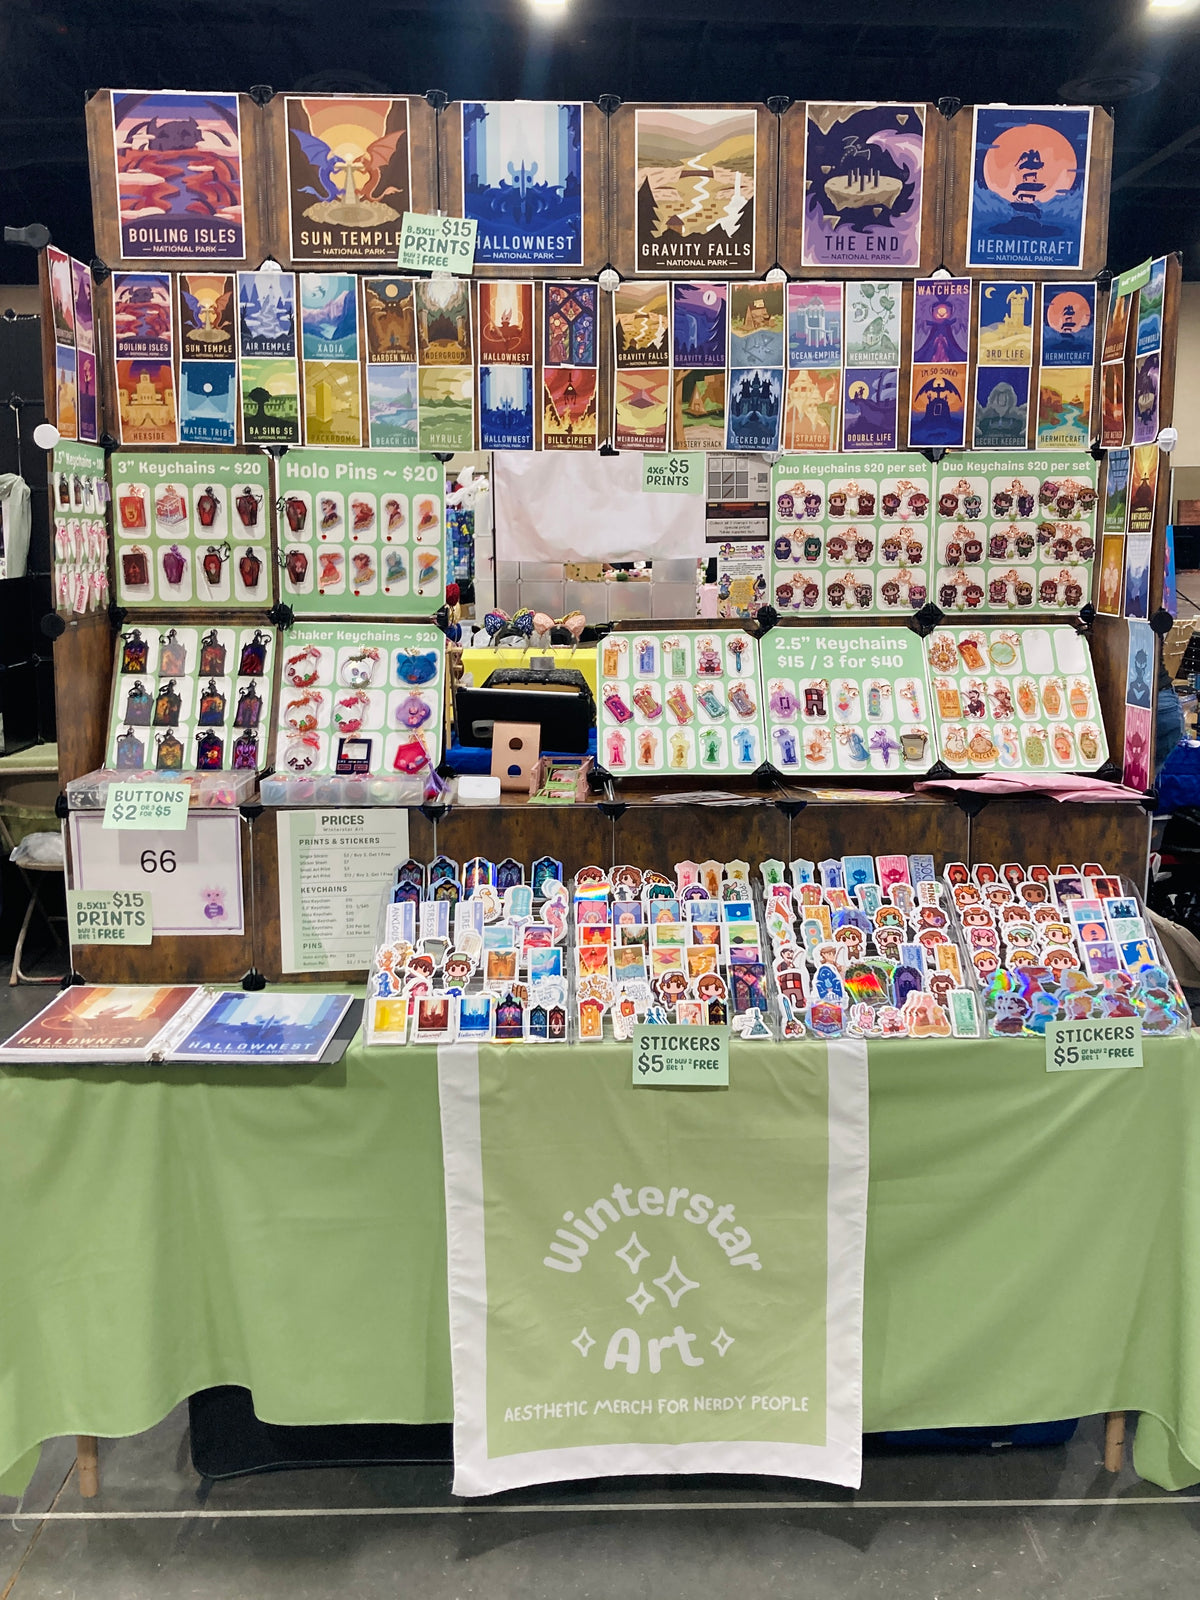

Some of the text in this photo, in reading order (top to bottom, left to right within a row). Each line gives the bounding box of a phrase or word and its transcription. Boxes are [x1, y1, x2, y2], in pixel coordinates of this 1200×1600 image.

[442, 220, 472, 237] $15
[129, 228, 236, 244] BOILING ISLES
[301, 231, 401, 246] SUN TEMPLE
[404, 235, 470, 257] PRINTS
[474, 235, 574, 250] HALLOWNEST
[825, 235, 898, 250] THE END
[977, 239, 1073, 255] HERMITCRAFT
[642, 243, 751, 257] GRAVITY FALLS
[422, 255, 448, 266] FREE
[492, 252, 554, 261] NATIONAL PARK
[831, 253, 869, 261] NATIONAL
[996, 254, 1037, 262] NATIONAL
[918, 285, 969, 295] WATCHERS
[120, 343, 146, 351] BOILING
[204, 345, 232, 353] TEMPLE
[262, 343, 290, 351] TEMPLE
[318, 344, 343, 352] XADIA
[483, 352, 529, 362] HALLOWNEST
[791, 351, 839, 359] OCEAN EMPIRE
[850, 352, 895, 361] HERMITCRAFT
[986, 350, 1024, 358] 3RD LIFE
[1045, 352, 1090, 360] HERMITCRAFT
[183, 427, 207, 435] WATER
[284, 427, 293, 435] SE
[430, 434, 463, 443] HYRULE
[484, 435, 529, 443] HALLOWNEST
[567, 436, 592, 444] CIPHER
[731, 436, 758, 444] DECKED
[139, 461, 215, 477] Keychains
[234, 462, 261, 475] $20
[286, 462, 438, 483] Holo Pins $20
[669, 458, 689, 475] $5
[778, 463, 927, 477] Duo Keychains $20 per set
[942, 461, 1090, 475] Duo Keychains $20 per set
[647, 476, 689, 486] PRINTS
[290, 630, 437, 644] Shaker Keychains $20
[775, 636, 907, 653] 2.5" Keychains
[778, 655, 903, 669] $15 3 for $40
[115, 791, 184, 803] BUTTONS
[112, 803, 137, 822] $2
[155, 805, 171, 817] $5
[322, 816, 364, 825] PRICES
[141, 850, 176, 873] 66
[112, 892, 144, 909] $15
[77, 911, 145, 926] PRINTS
[98, 929, 125, 939] FREE
[1056, 1026, 1134, 1043] STICKERS
[17, 1037, 143, 1045] HALLOWNEST
[188, 1042, 314, 1050] HALLOWNEST
[640, 1037, 720, 1051] STICKERS
[1054, 1046, 1079, 1066] $5
[1109, 1048, 1134, 1058] FREE
[638, 1053, 664, 1075] $5
[694, 1060, 718, 1070] FREE
[543, 1183, 762, 1273] Winterstar
[604, 1325, 704, 1374] Art
[504, 1396, 809, 1423] AESTHETIC MERCH FOR NERDY PEOPLE
